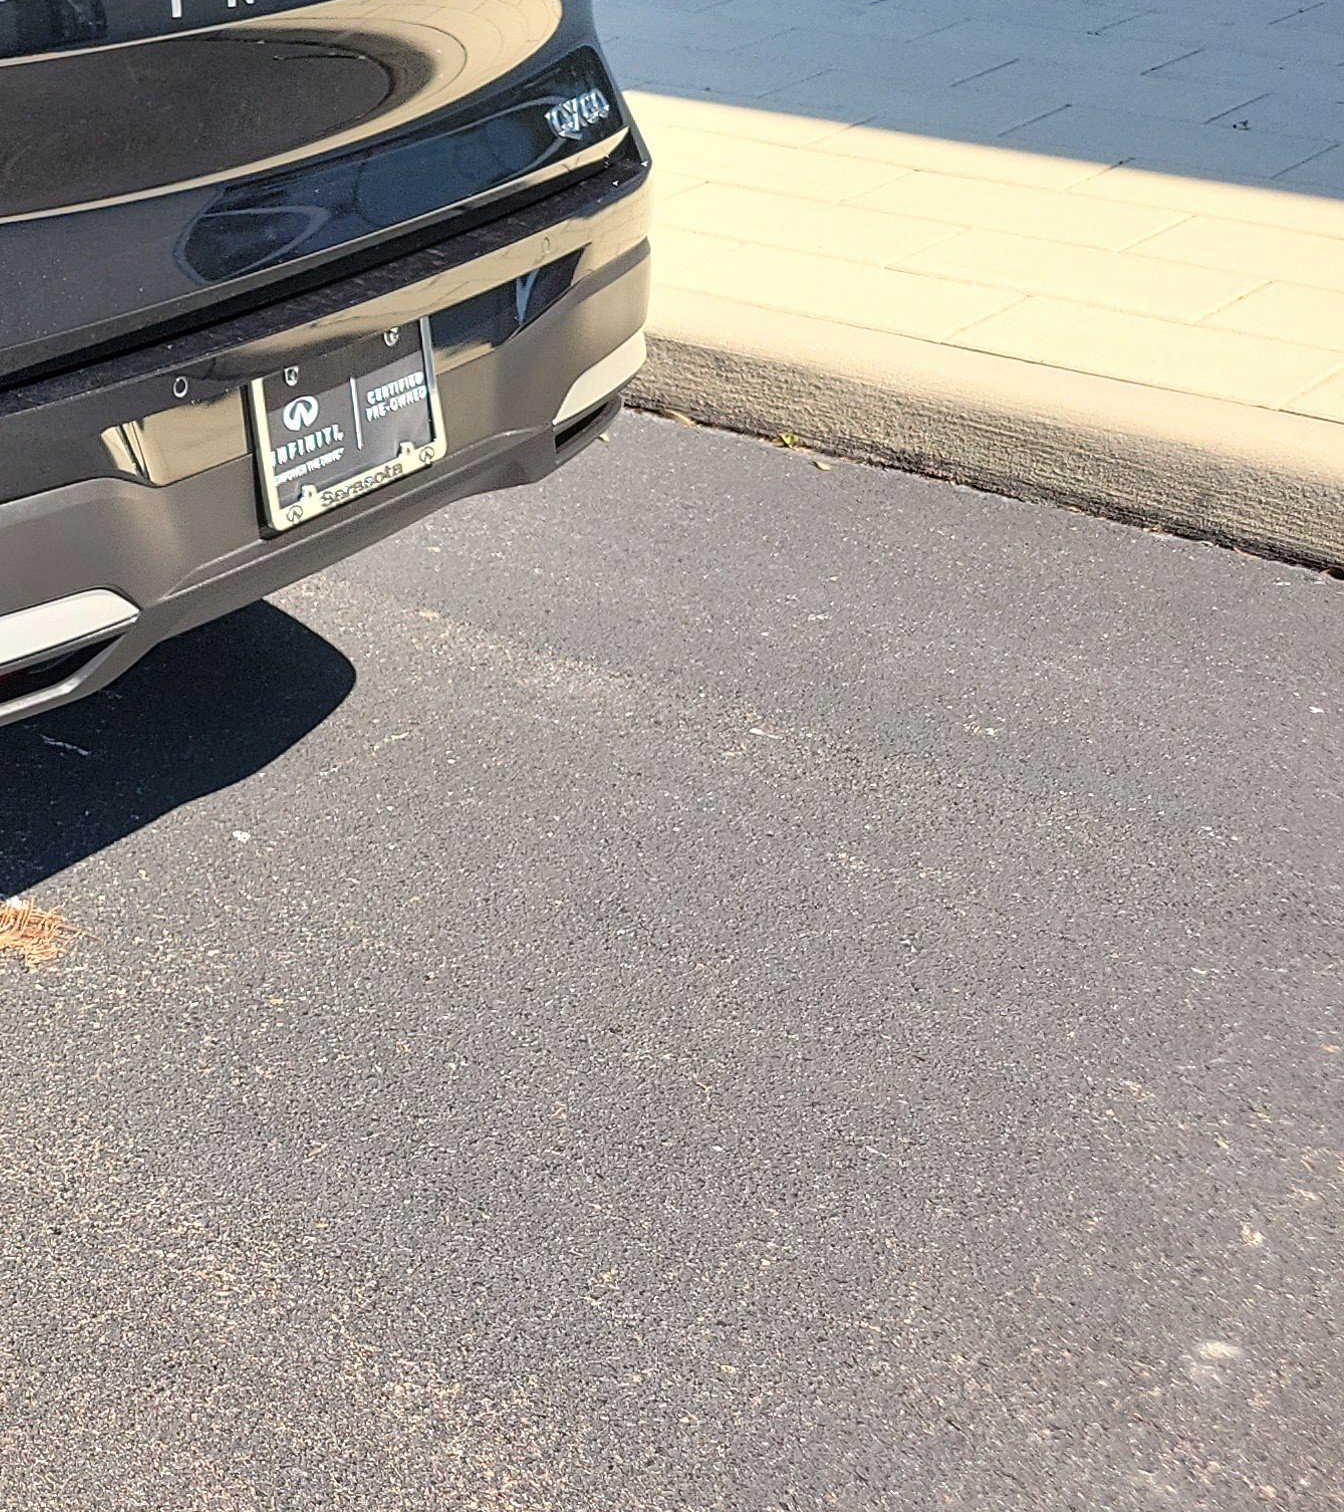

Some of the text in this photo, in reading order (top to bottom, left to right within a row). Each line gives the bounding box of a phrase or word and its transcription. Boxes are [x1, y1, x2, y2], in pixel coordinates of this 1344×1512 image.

[365, 385, 427, 422] PRE-OWNED
[367, 371, 424, 405] CERTIFIED
[320, 463, 403, 507] Sarasota
